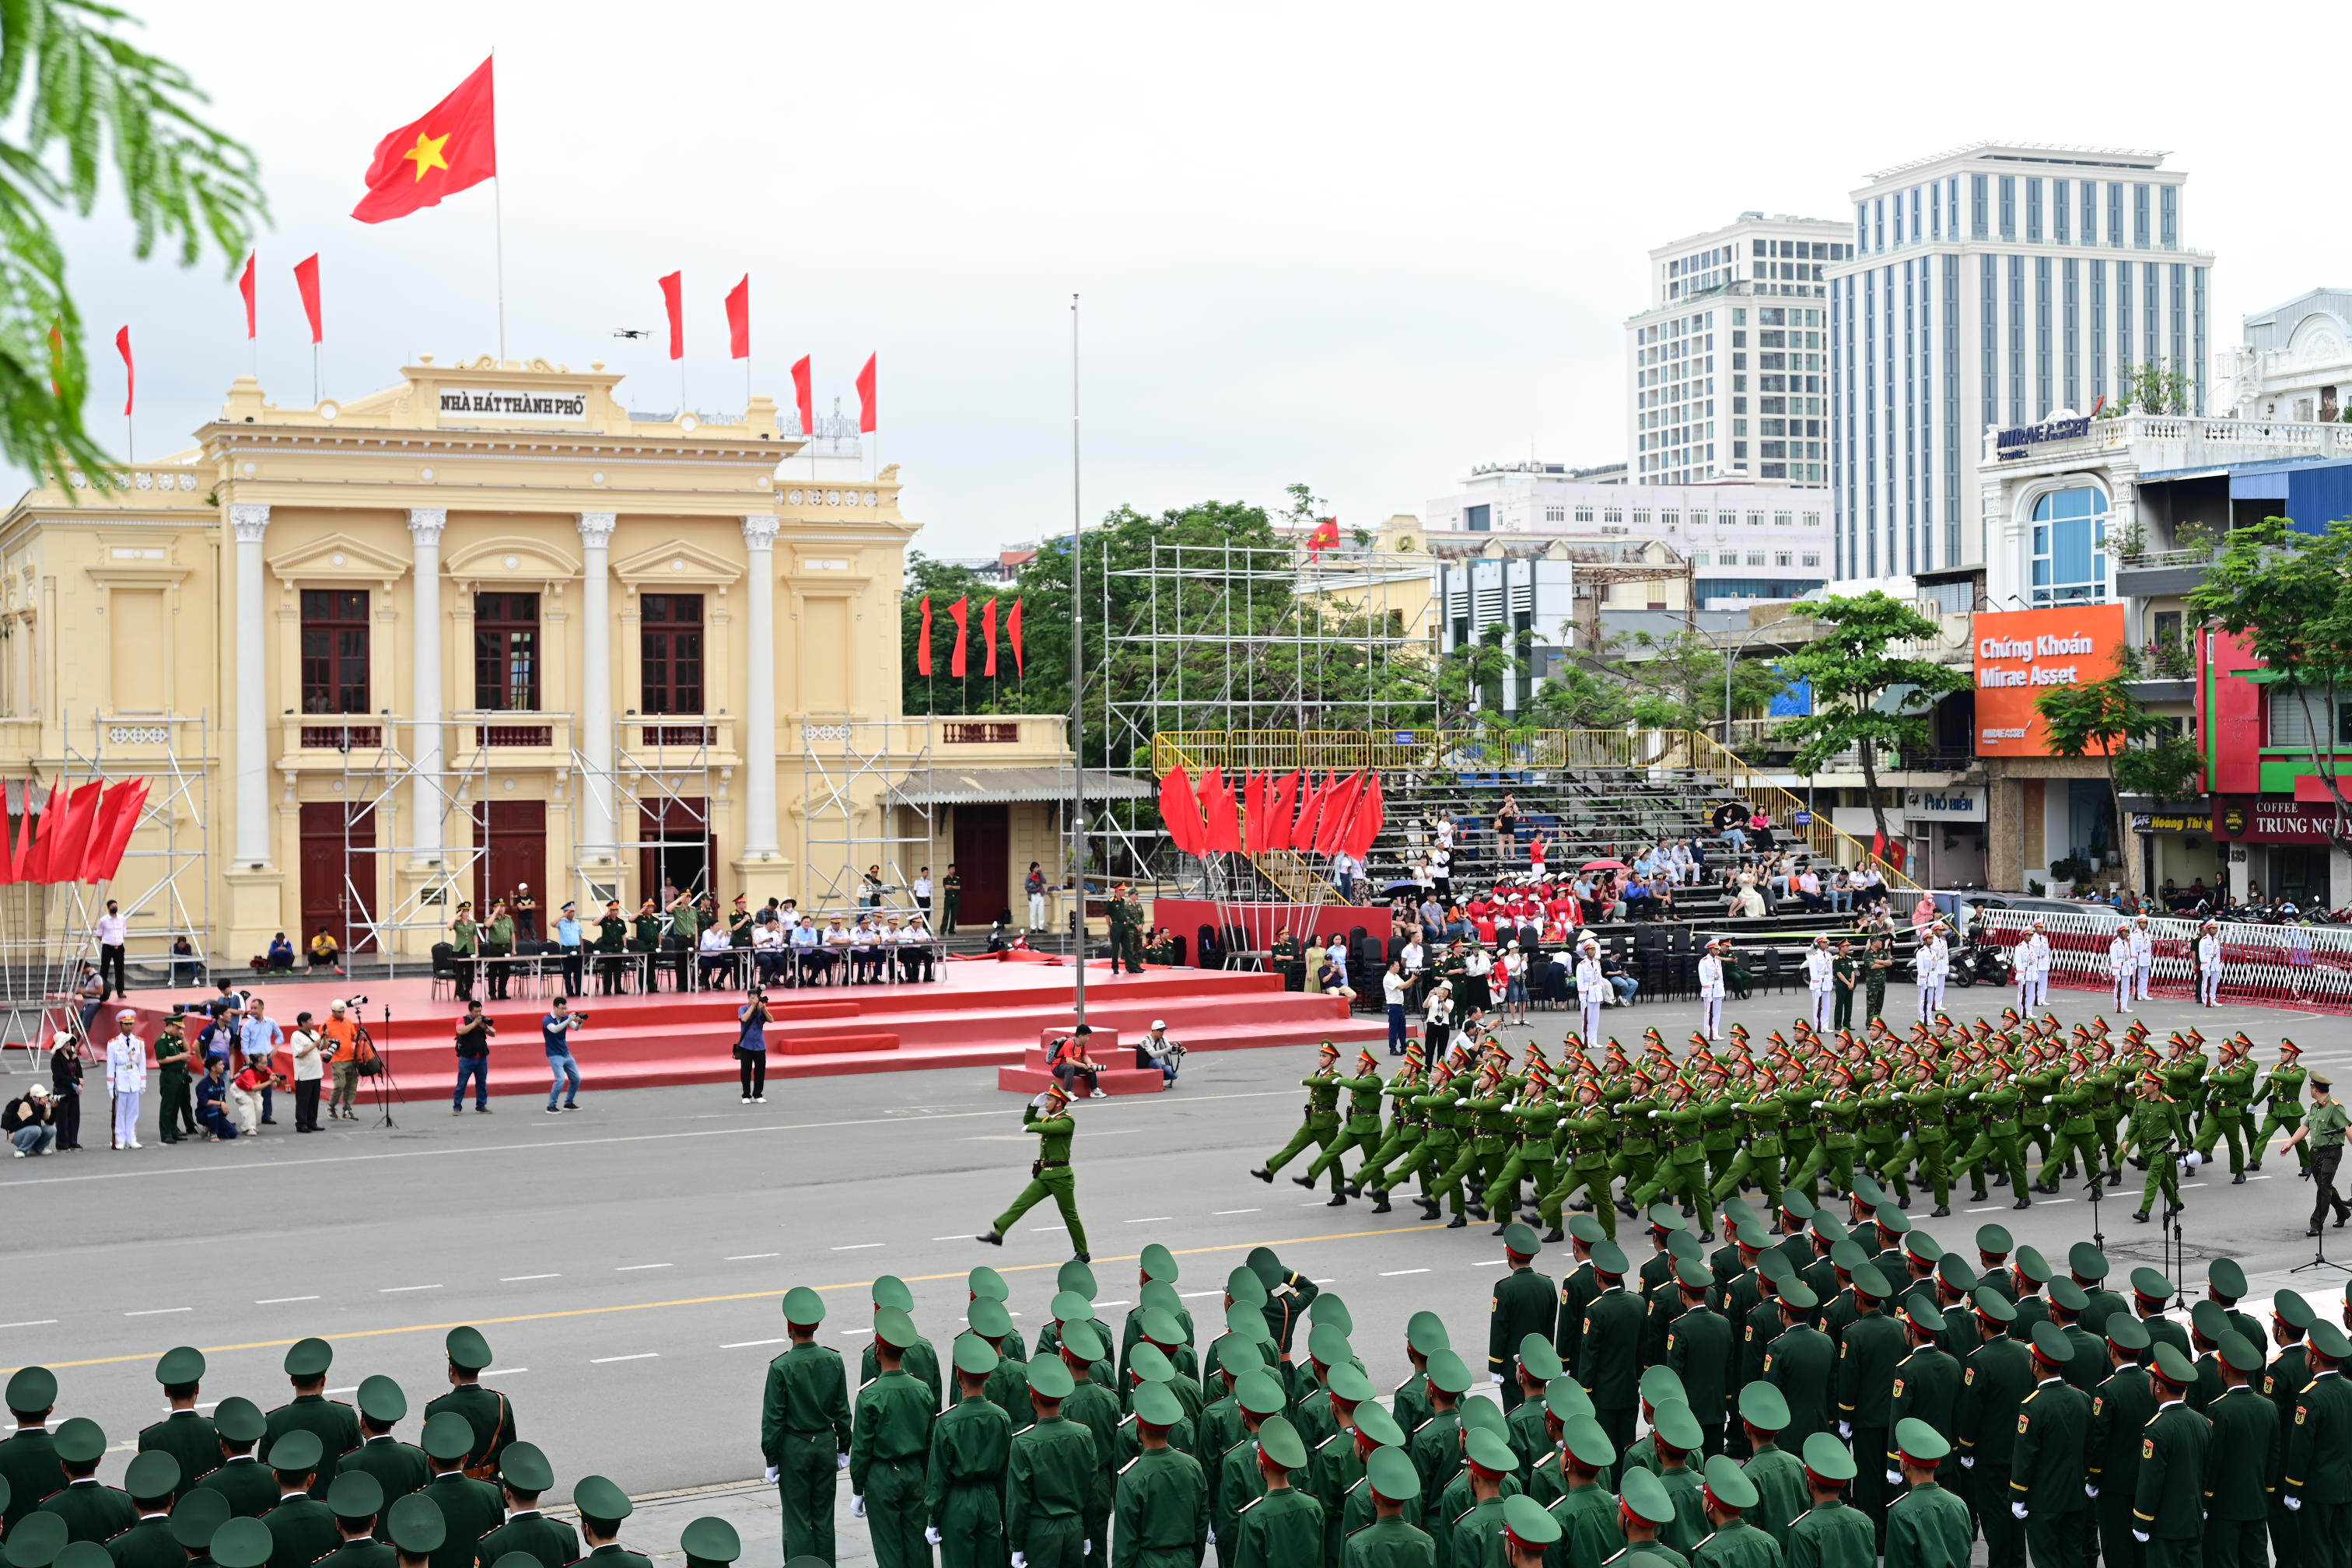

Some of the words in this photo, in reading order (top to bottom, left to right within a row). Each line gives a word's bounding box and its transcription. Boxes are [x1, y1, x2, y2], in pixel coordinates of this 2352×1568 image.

[440, 391, 471, 411] NHÀ
[473, 392, 502, 412] HÁT
[503, 393, 553, 415] THÀNH
[555, 395, 586, 416] PHỐ
[1997, 425, 2044, 448] MIRAE
[2044, 416, 2091, 441] ASSET
[1980, 635, 2034, 663] Chứng
[2036, 631, 2093, 656] Khoán
[1980, 666, 2028, 688] Mirae
[2029, 665, 2078, 686] Asset
[1982, 729, 2005, 738] MIRAE
[2004, 728, 2026, 738] ASSET
[2256, 802, 2298, 814] COFFEE
[2256, 817, 2308, 834] TRUNG
